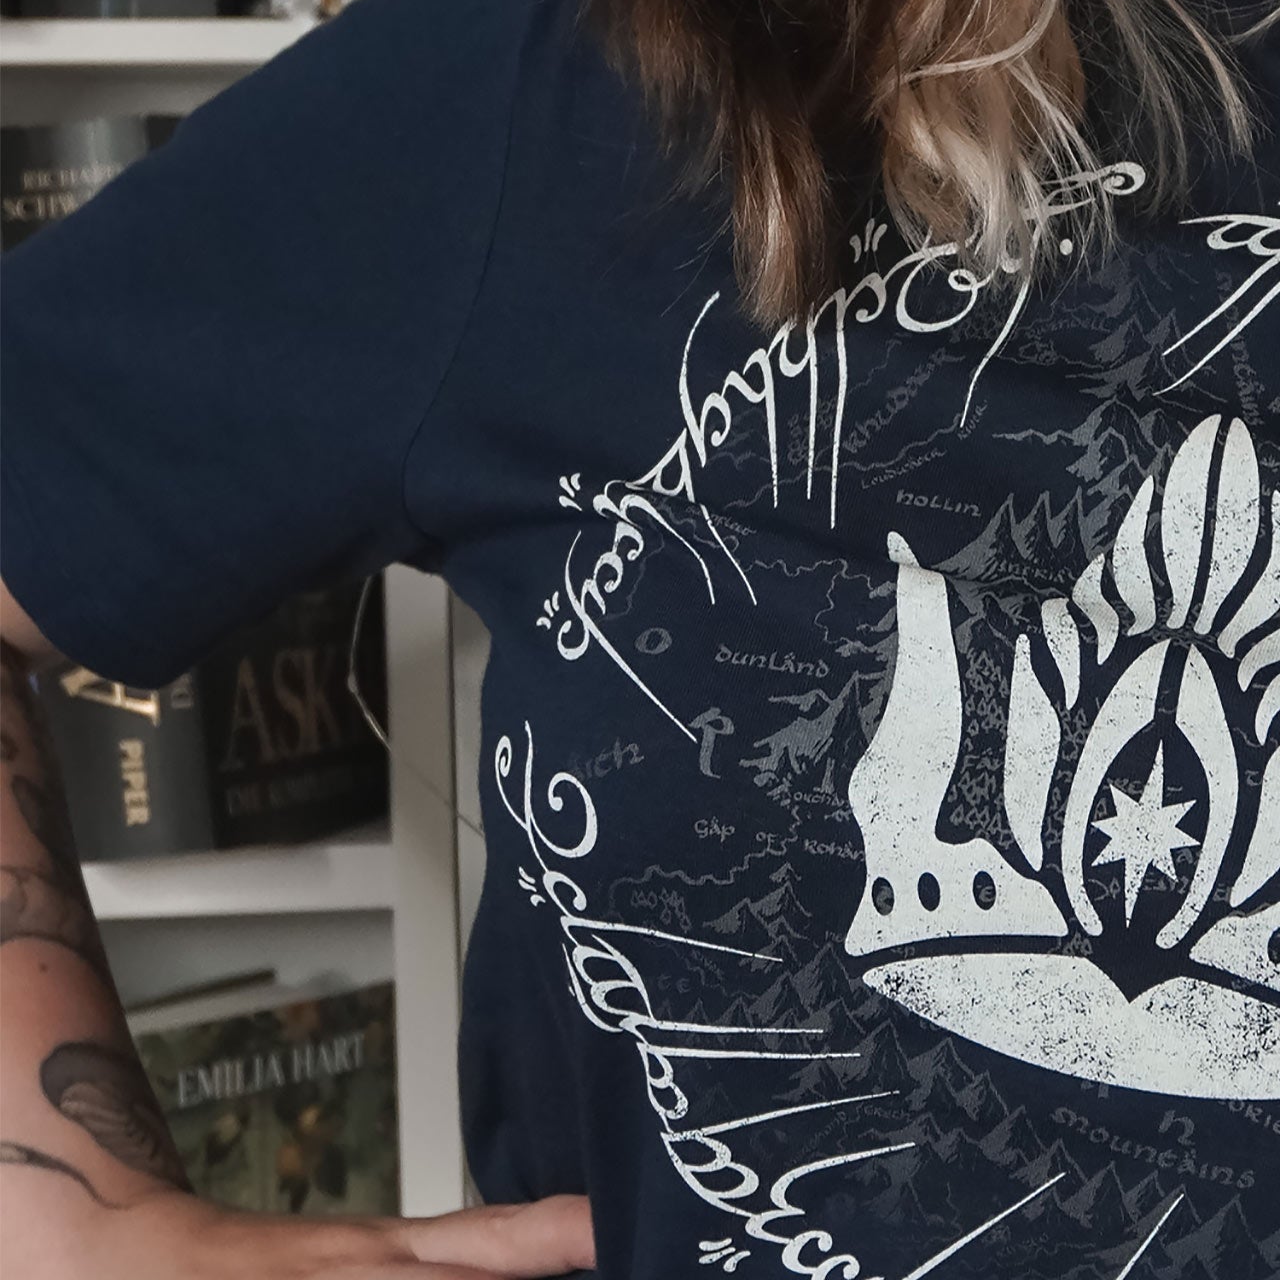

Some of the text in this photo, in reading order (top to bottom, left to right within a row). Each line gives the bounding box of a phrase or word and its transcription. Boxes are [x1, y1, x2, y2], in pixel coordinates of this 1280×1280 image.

[117, 736, 152, 828] PIPER
[176, 1031, 366, 1110] EMILIA HART
